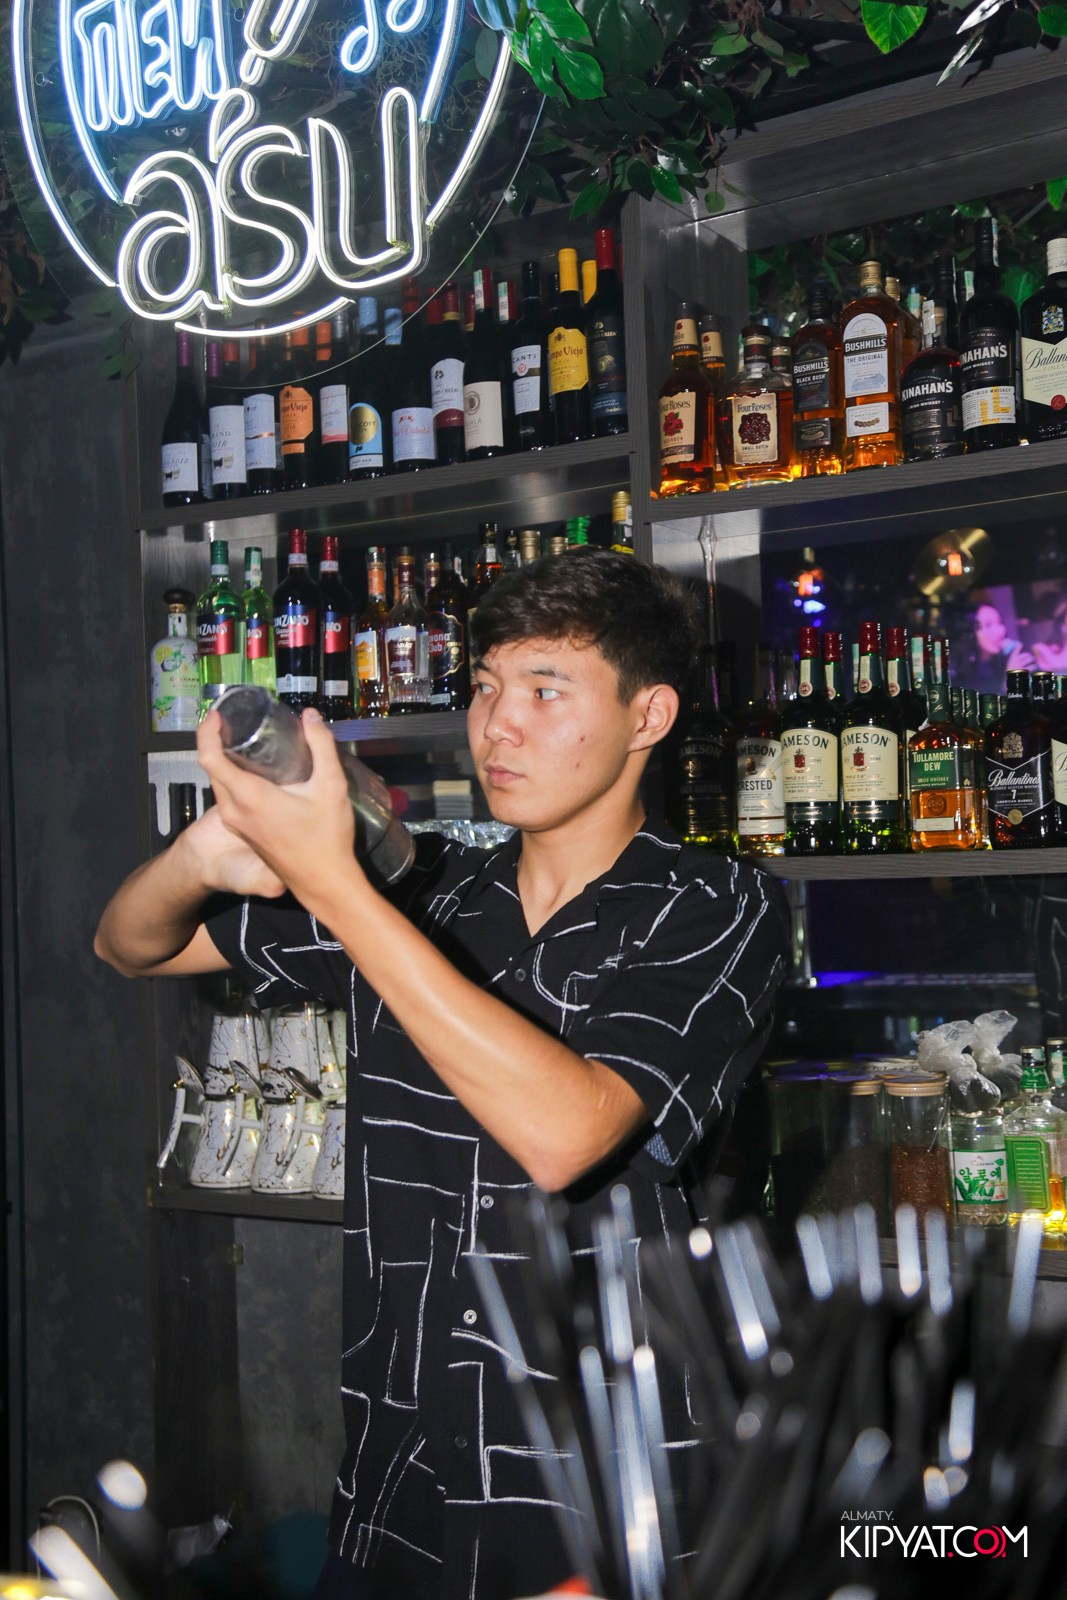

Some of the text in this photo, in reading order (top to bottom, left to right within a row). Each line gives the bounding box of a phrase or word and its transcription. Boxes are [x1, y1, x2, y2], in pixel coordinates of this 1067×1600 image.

[845, 338, 887, 353] BUSHMILLS
[563, 346, 584, 357] Viejo
[960, 342, 1008, 366] NAHAN'S
[858, 354, 884, 363] ORIGINAL
[793, 361, 829, 374] BUSHMILLS
[796, 373, 826, 384] BLACK BUSH
[901, 378, 954, 402] KINAHAN'S
[669, 400, 691, 410] Roses
[737, 402, 772, 413] Four Roses
[274, 614, 310, 628] INZANO
[842, 732, 889, 748] AMESON
[912, 751, 955, 763] TULLAMORE
[924, 762, 941, 771] DEW
[1011, 789, 1017, 800] 7
